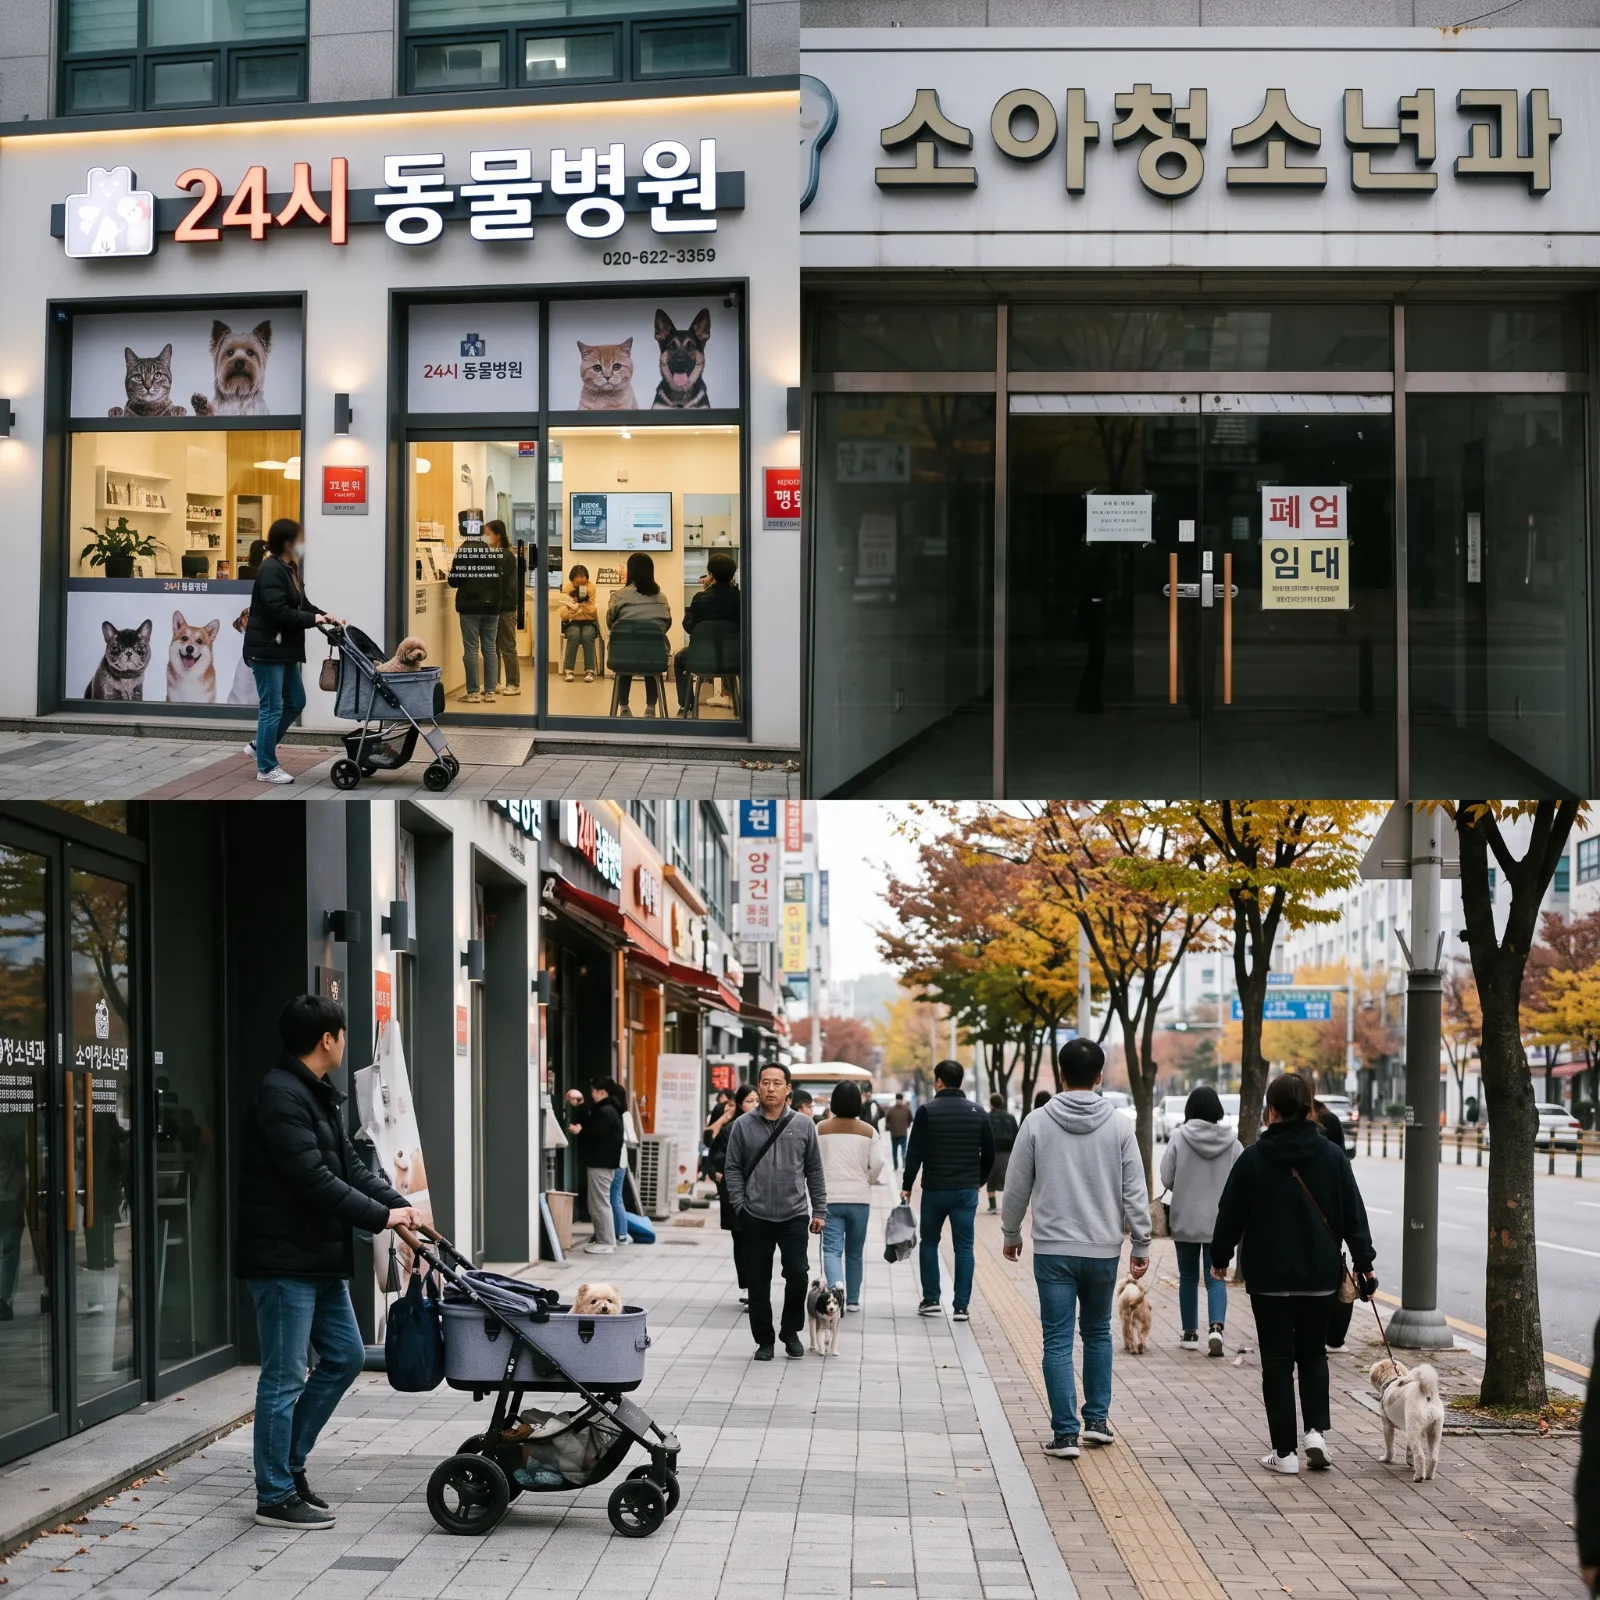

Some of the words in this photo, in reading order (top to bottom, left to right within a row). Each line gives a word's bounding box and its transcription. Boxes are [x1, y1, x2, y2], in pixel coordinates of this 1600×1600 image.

[875, 83, 1562, 200] 소아청소년과
[174, 157, 348, 245] 24시
[374, 138, 717, 245] 동물병원
[603, 248, 716, 266] 020-622-3359
[423, 363, 458, 379] 24시
[462, 361, 522, 380] 동물병원
